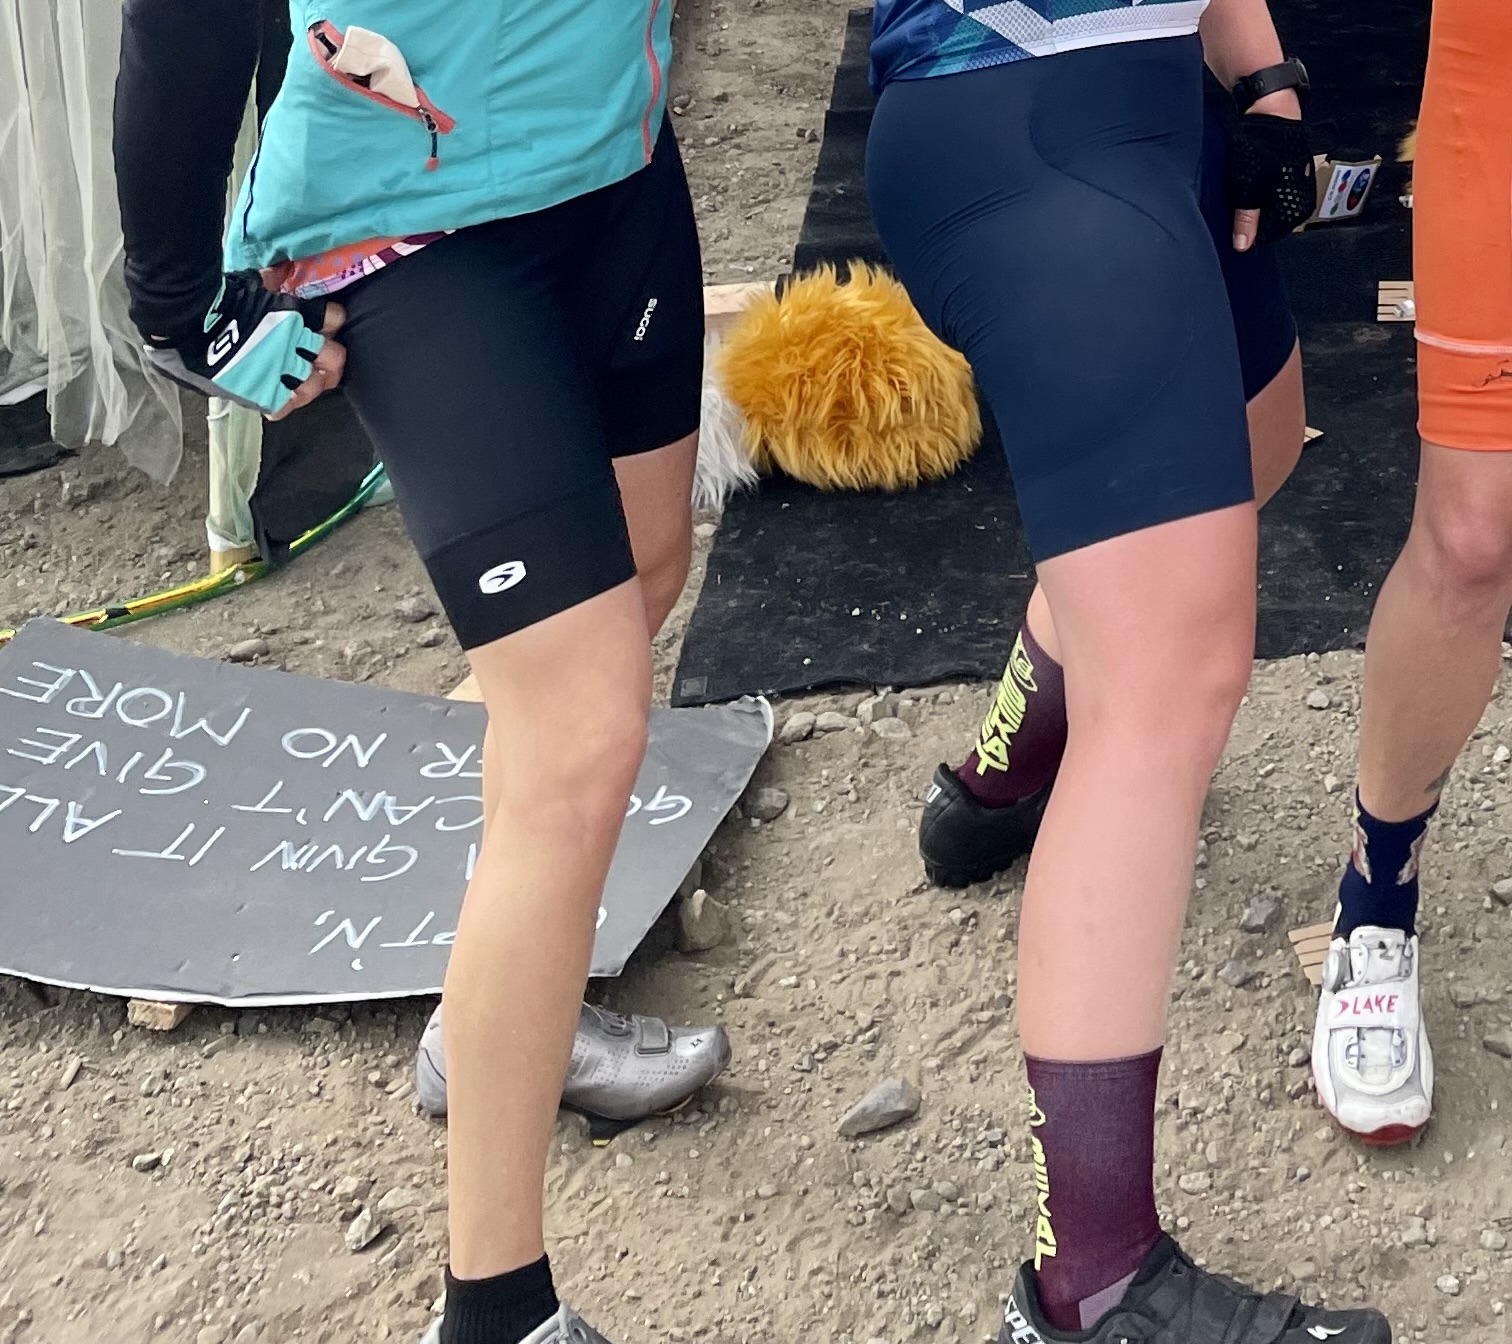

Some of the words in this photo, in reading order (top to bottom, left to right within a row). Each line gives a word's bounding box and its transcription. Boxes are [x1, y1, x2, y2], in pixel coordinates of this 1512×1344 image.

[0, 661, 253, 747] MORE
[6, 726, 207, 796] GIVE
[281, 727, 388, 768] NO
[0, 784, 123, 843] ALL
[230, 780, 485, 832] CAN'T
[111, 822, 226, 867] IT
[1352, 994, 1399, 1015] LAKE
